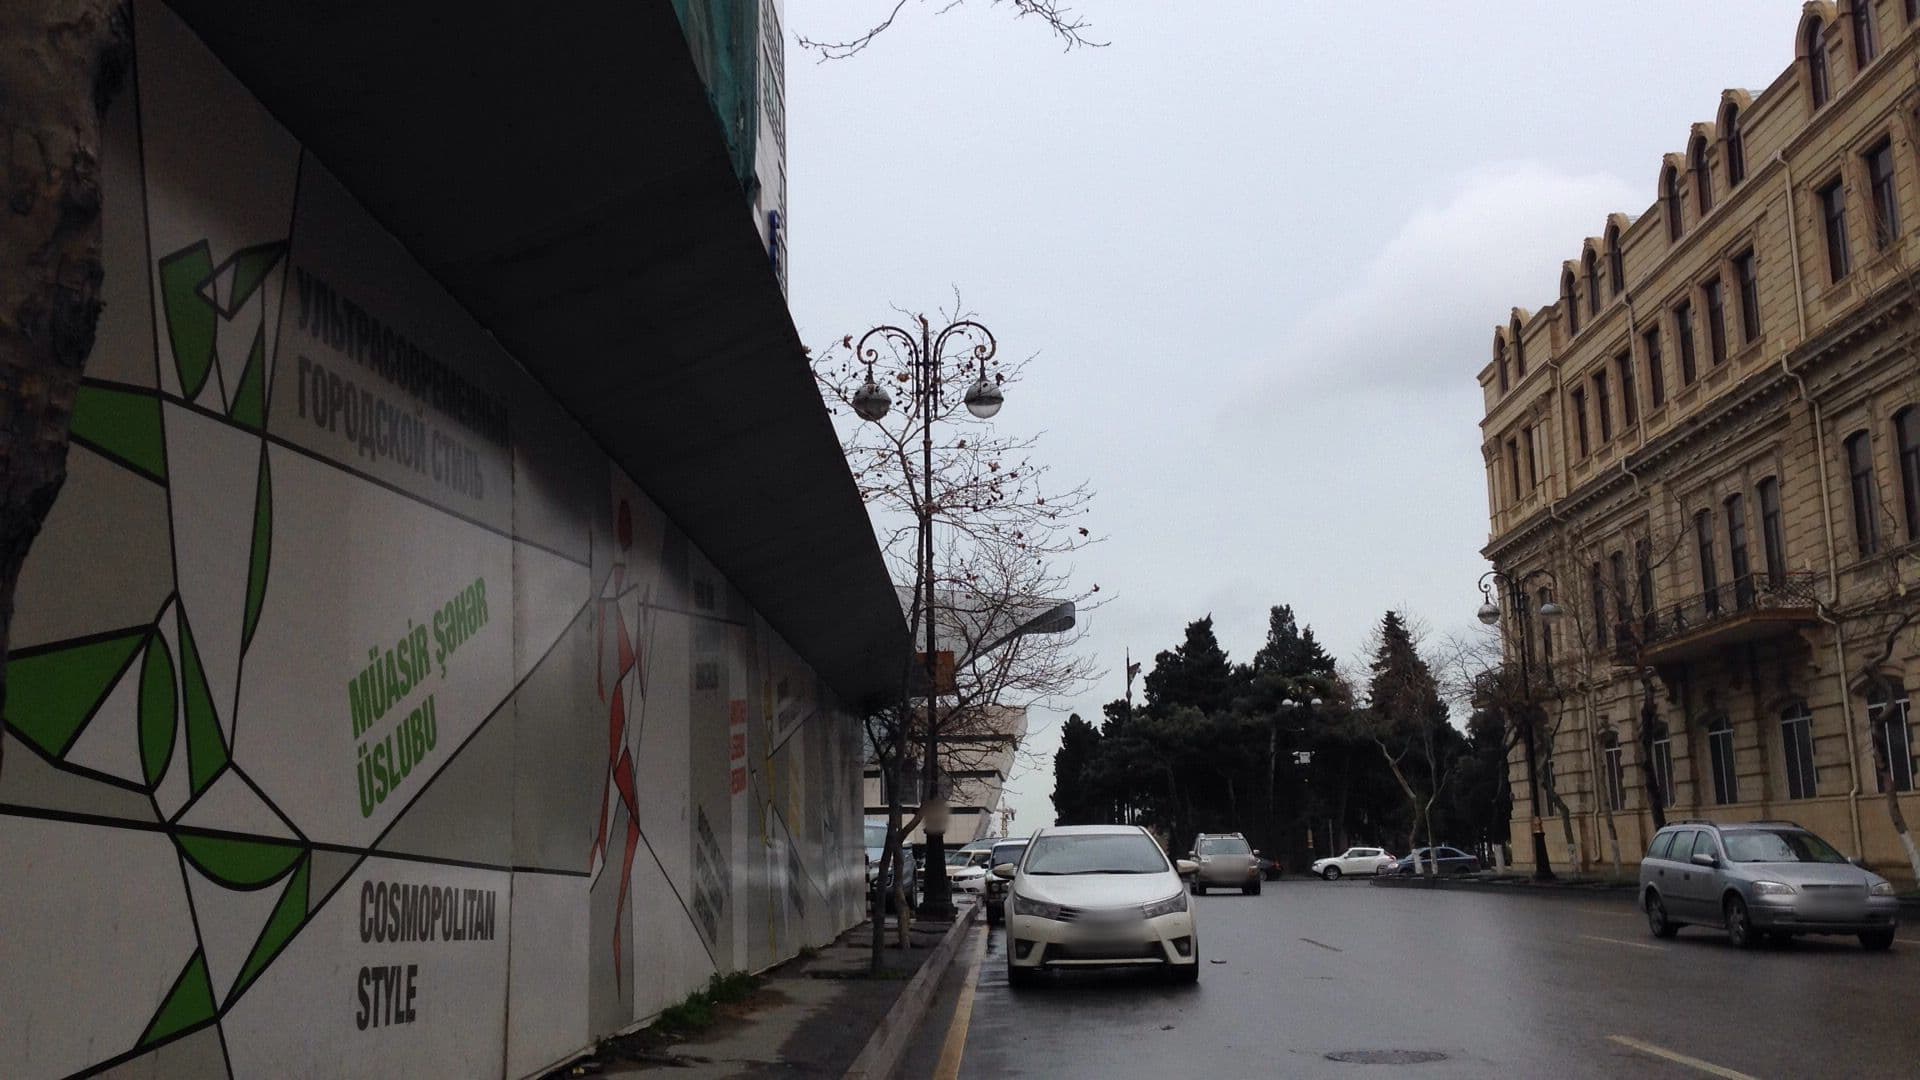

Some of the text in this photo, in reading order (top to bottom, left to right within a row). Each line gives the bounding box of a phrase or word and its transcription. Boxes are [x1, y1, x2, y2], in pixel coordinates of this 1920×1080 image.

[298, 355, 484, 500] ГОРОДСКОЙ СТИЛЬ
[349, 617, 431, 740] MÜASİR
[357, 693, 437, 819] ÜSLUBU
[360, 880, 496, 944] COSMOPOLITAN
[356, 964, 418, 1031] STYLE
